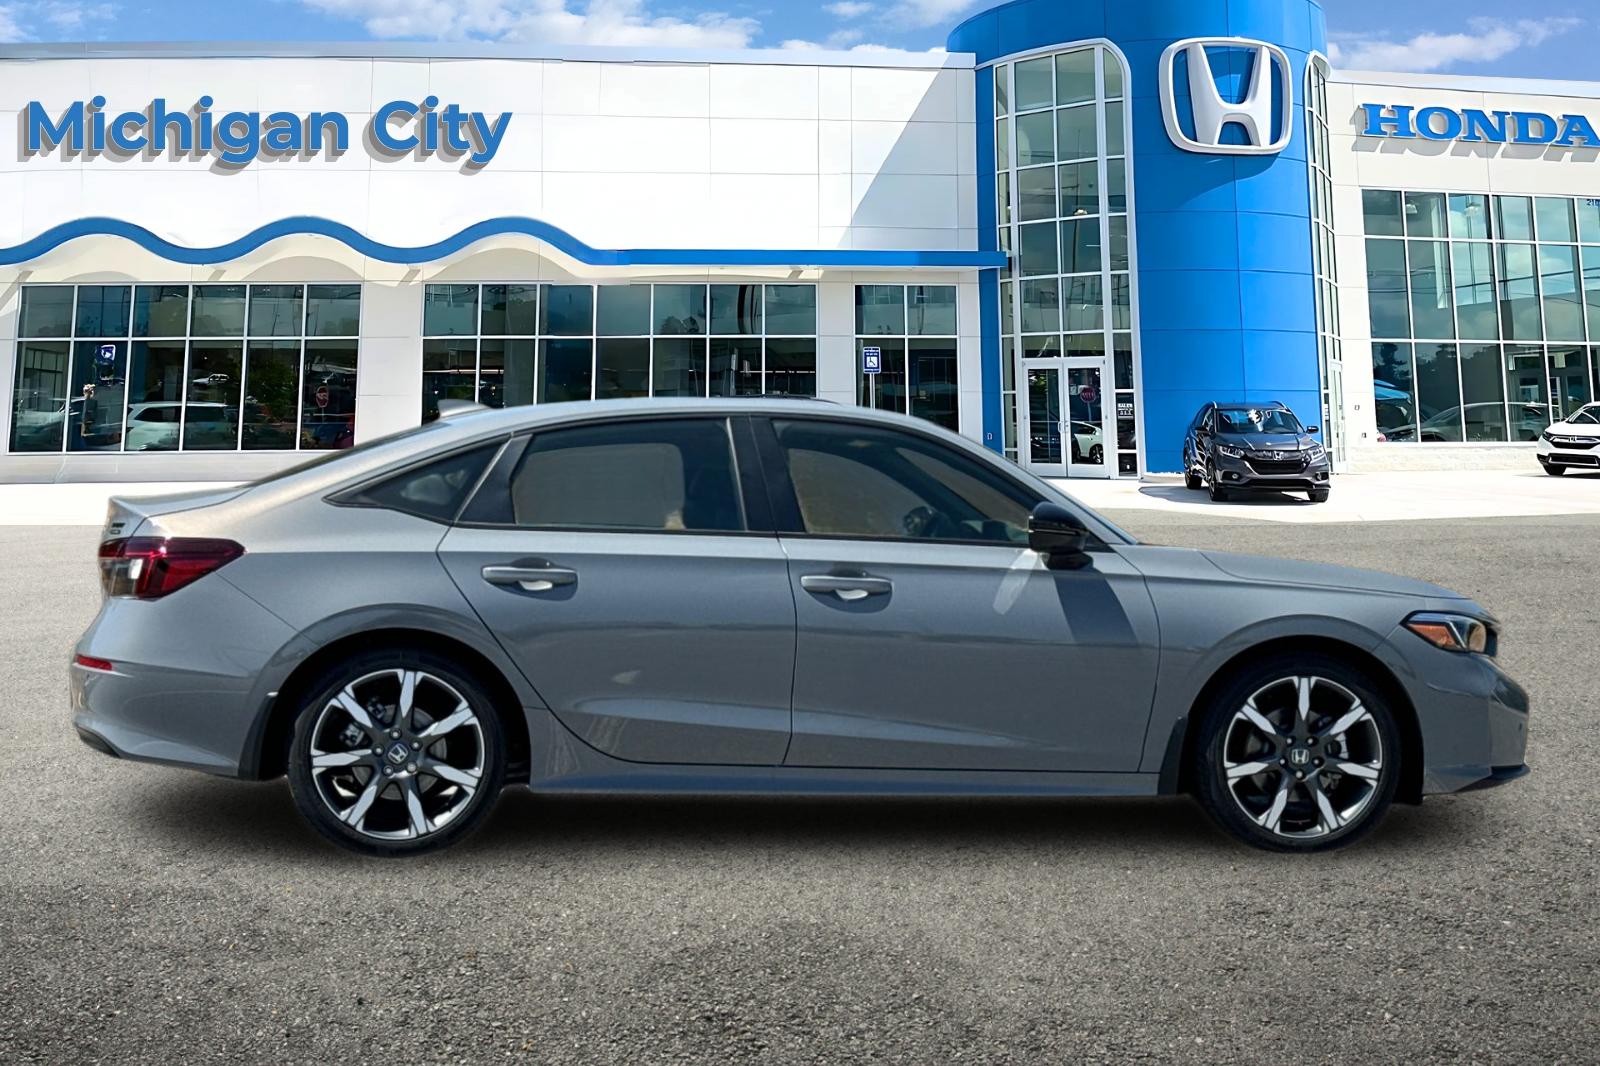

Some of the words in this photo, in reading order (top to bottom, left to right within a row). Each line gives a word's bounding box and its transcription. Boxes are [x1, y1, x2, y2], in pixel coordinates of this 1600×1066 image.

[28, 95, 349, 164] Michigan
[372, 95, 513, 164] City
[1361, 103, 1600, 147] HONDA
